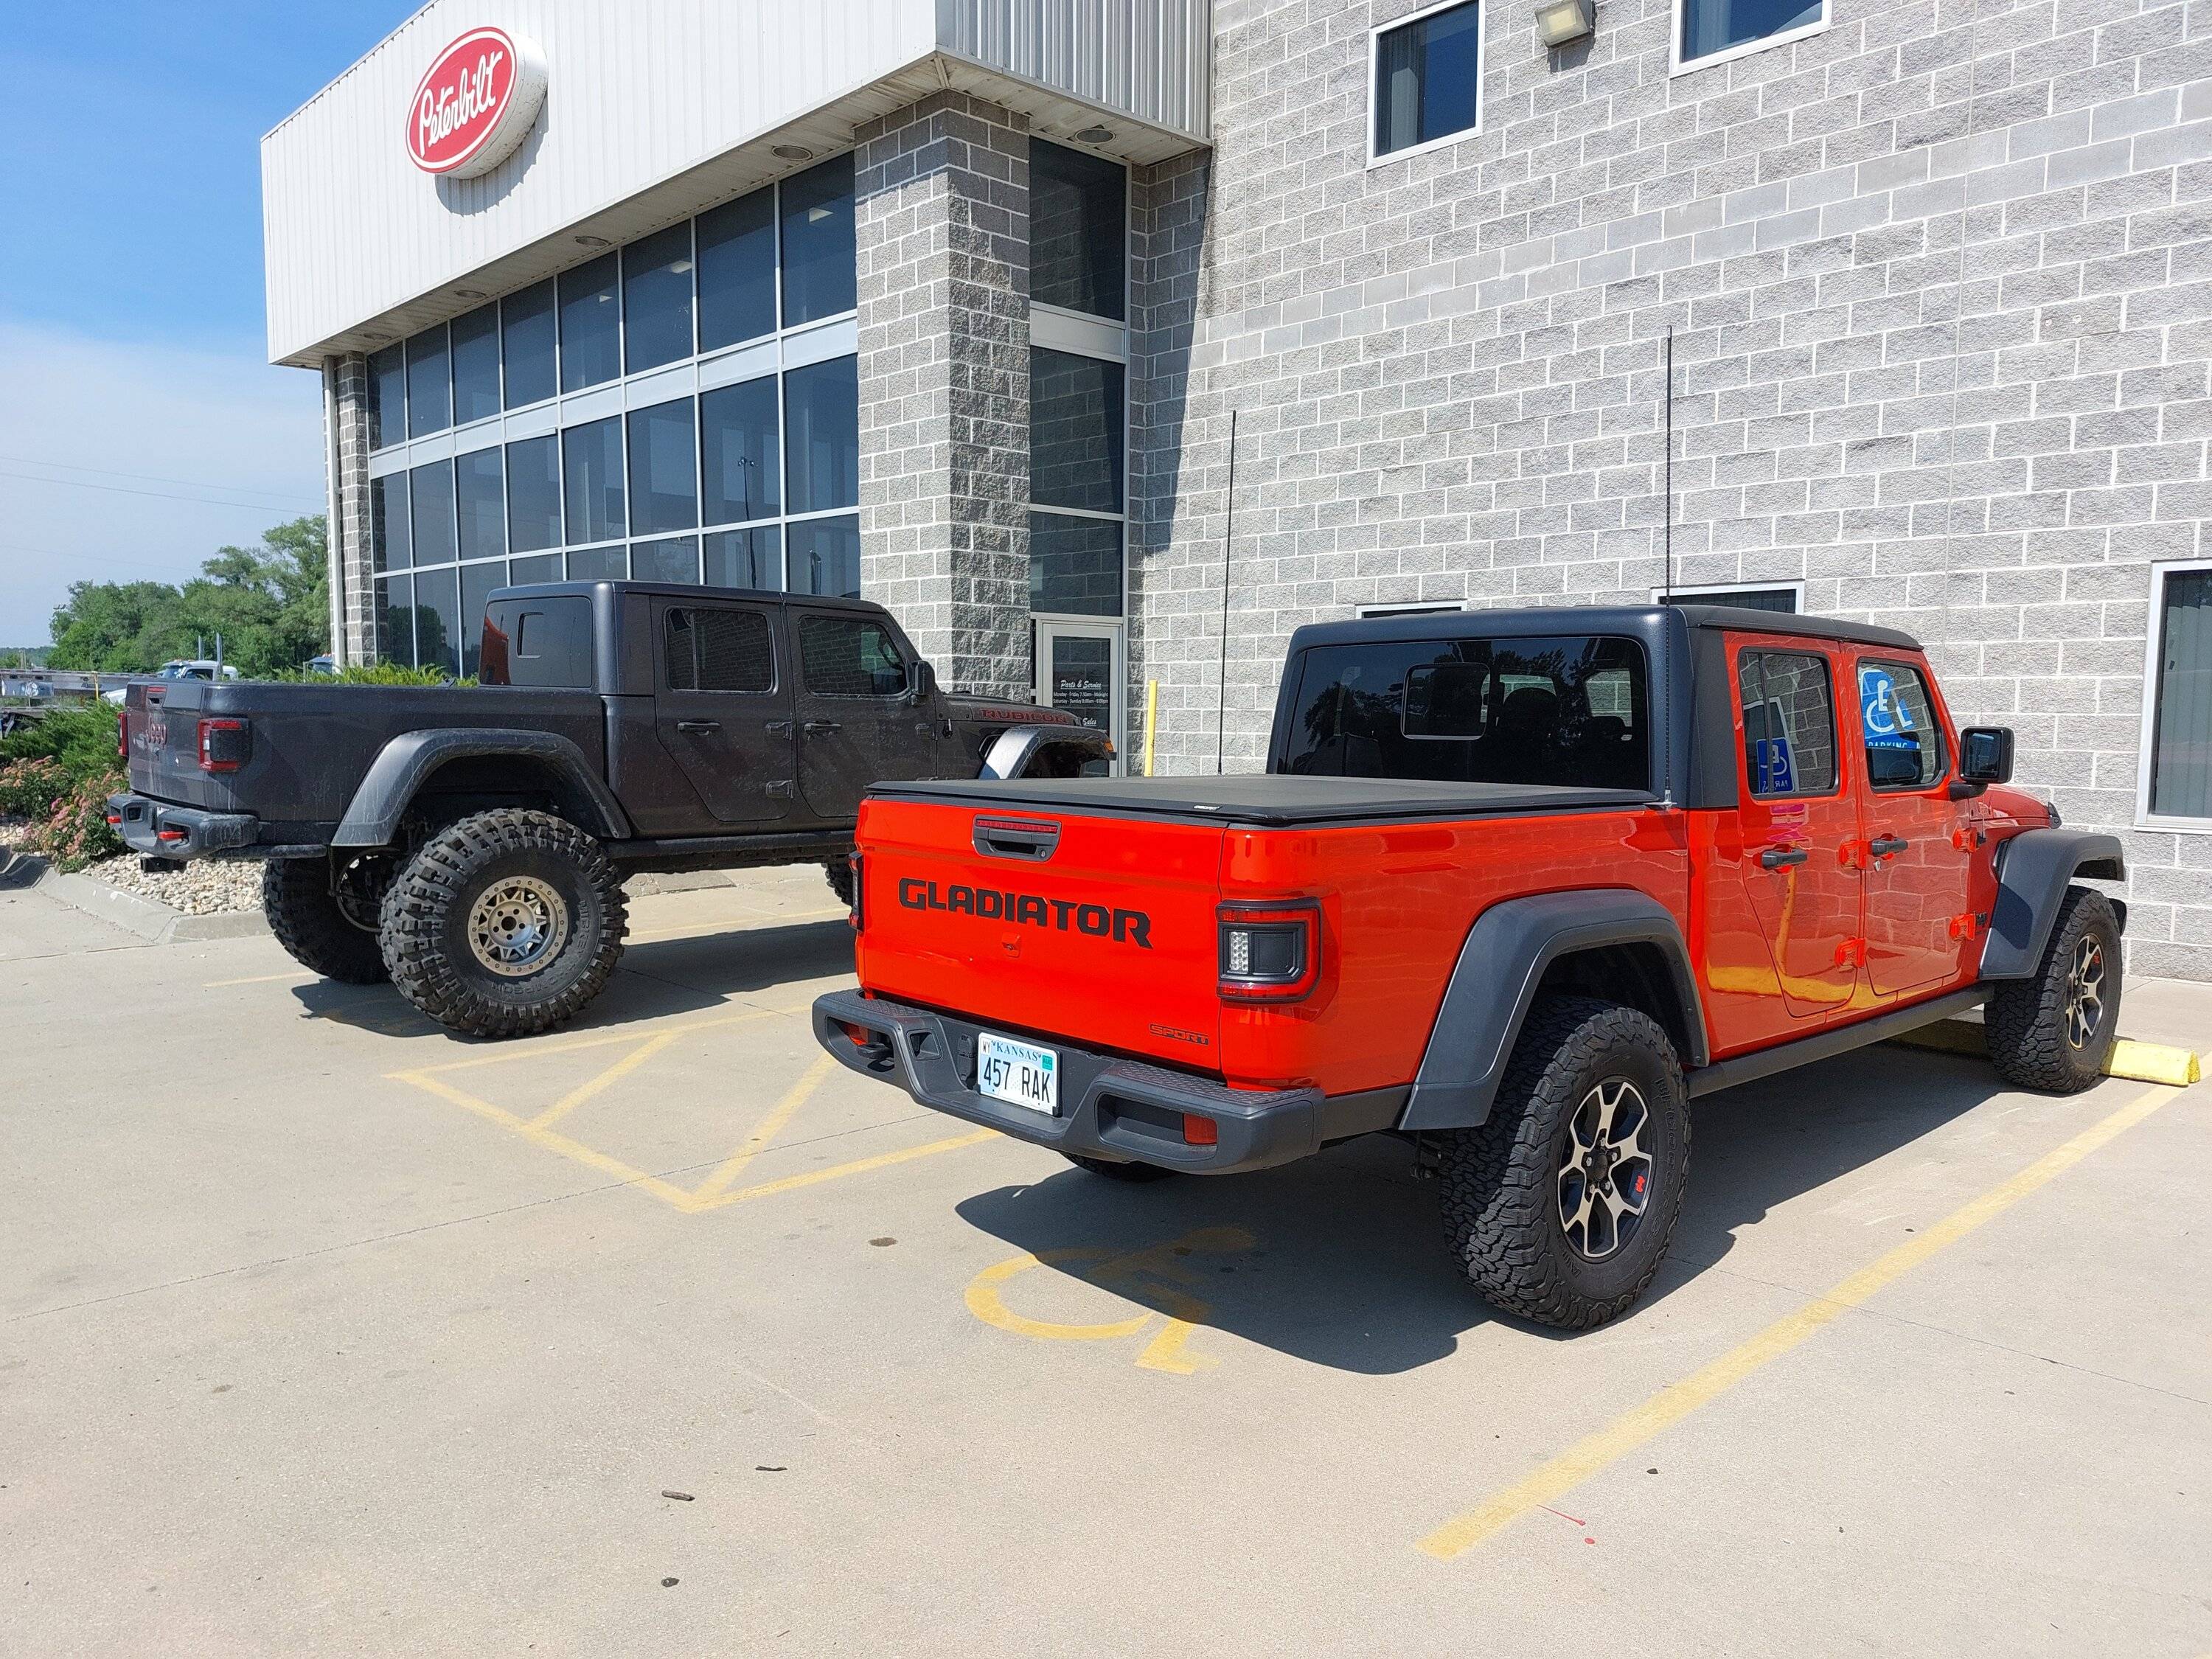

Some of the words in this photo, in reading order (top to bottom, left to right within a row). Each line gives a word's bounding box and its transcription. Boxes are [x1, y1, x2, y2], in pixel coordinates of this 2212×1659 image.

[419, 49, 504, 158] Peterbilt
[1060, 680, 1076, 689] Parts
[1077, 680, 1082, 688] &
[1082, 681, 1102, 689] Service
[981, 709, 1067, 723] RUBICON
[1082, 717, 1097, 726] Sales
[146, 713, 167, 748] Jeep
[897, 877, 1154, 950] GLADIATOR
[1150, 1024, 1209, 1046] SPORT
[982, 1041, 991, 1055] WY
[996, 1041, 1038, 1062] KANSAS
[984, 1057, 1011, 1091] 457
[1021, 1066, 1051, 1103] RAK
